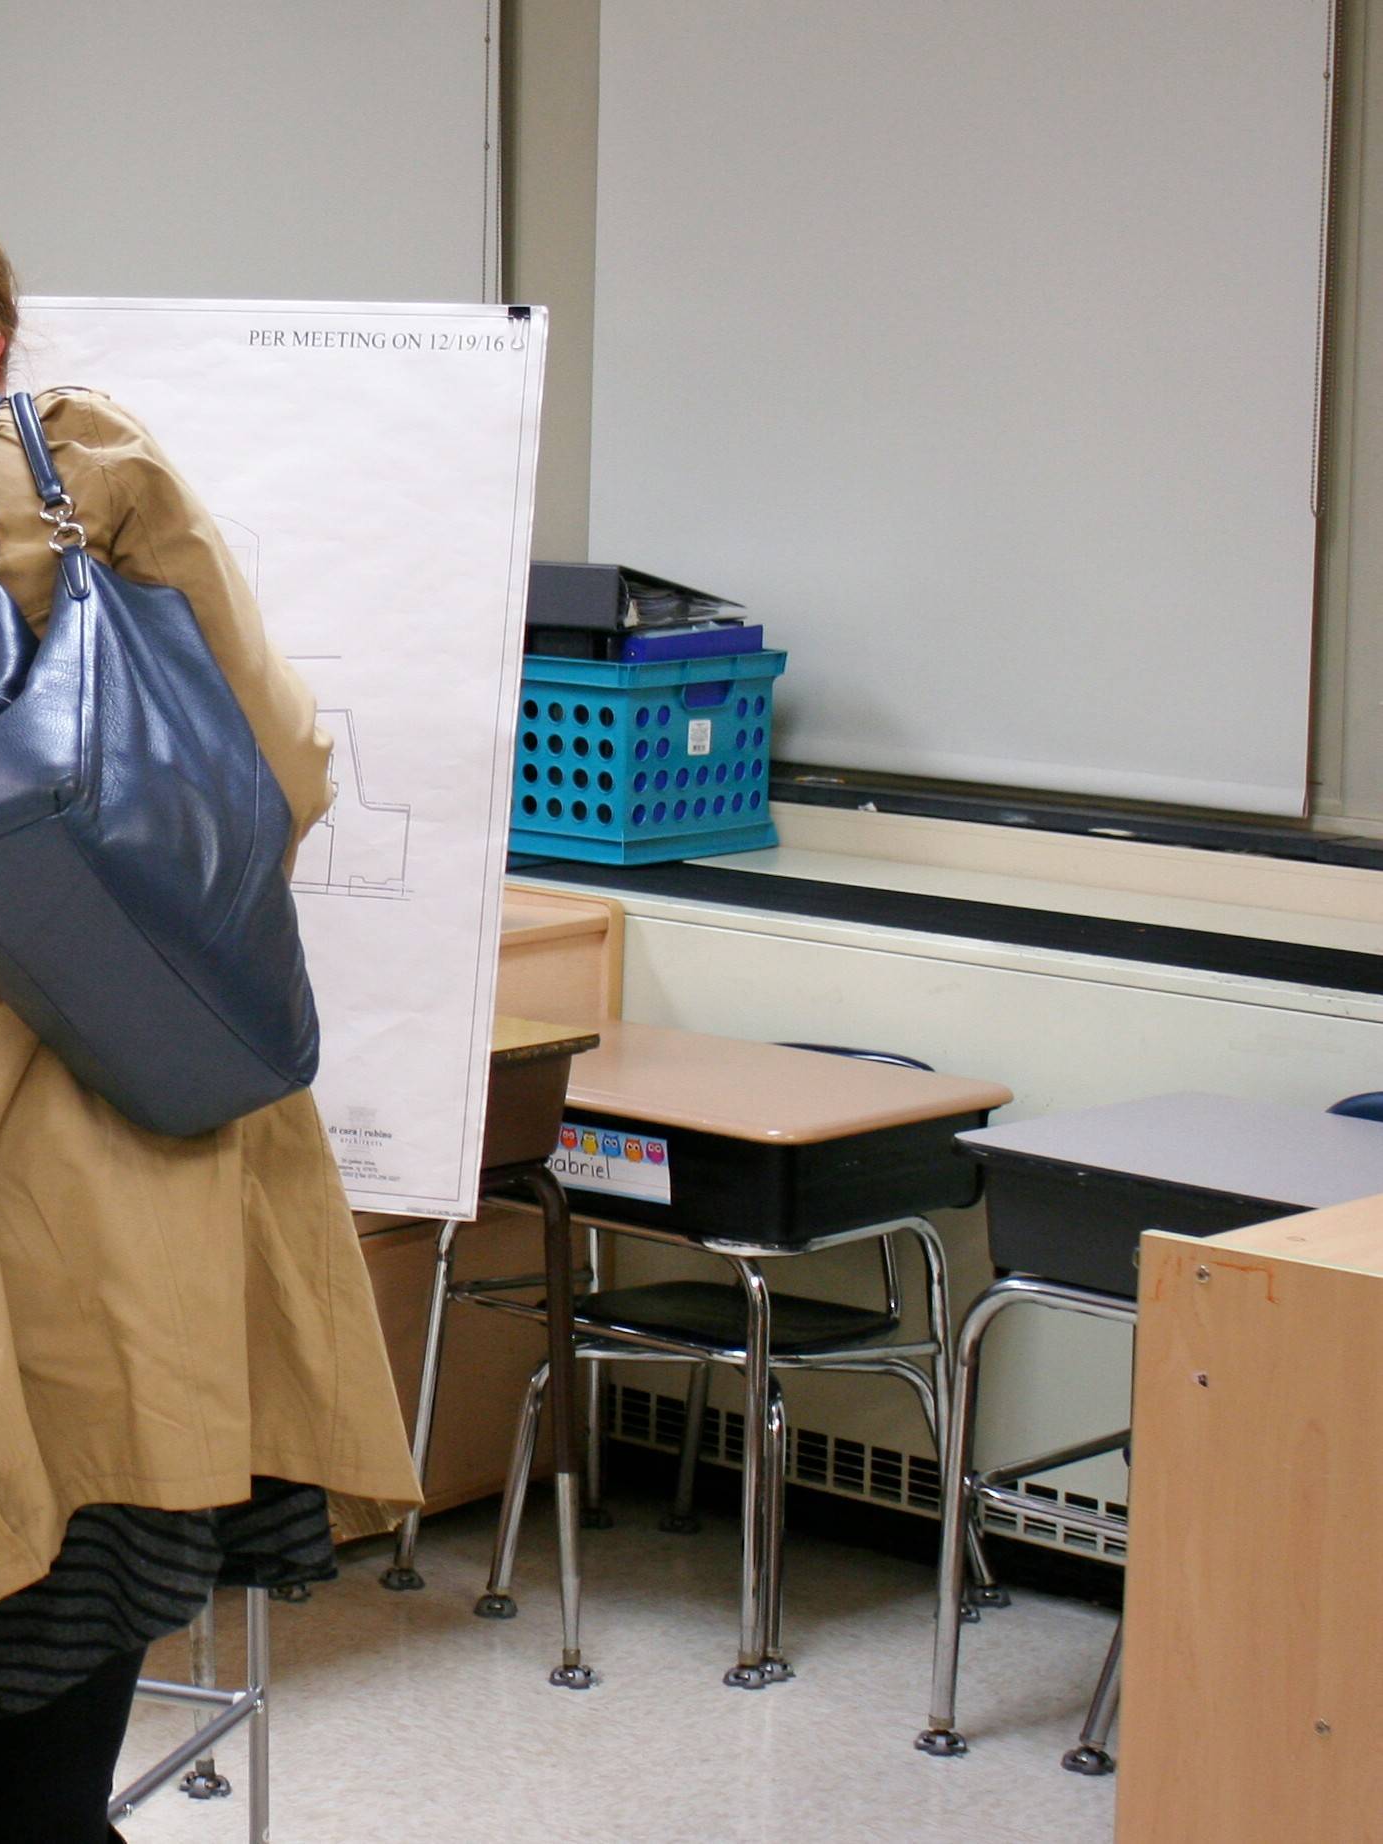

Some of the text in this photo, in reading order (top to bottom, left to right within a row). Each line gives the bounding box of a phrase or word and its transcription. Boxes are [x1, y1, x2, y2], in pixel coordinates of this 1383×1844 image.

[249, 330, 505, 351] PER MEETING ON 12/19/16
[363, 1129, 393, 1139] rubino
